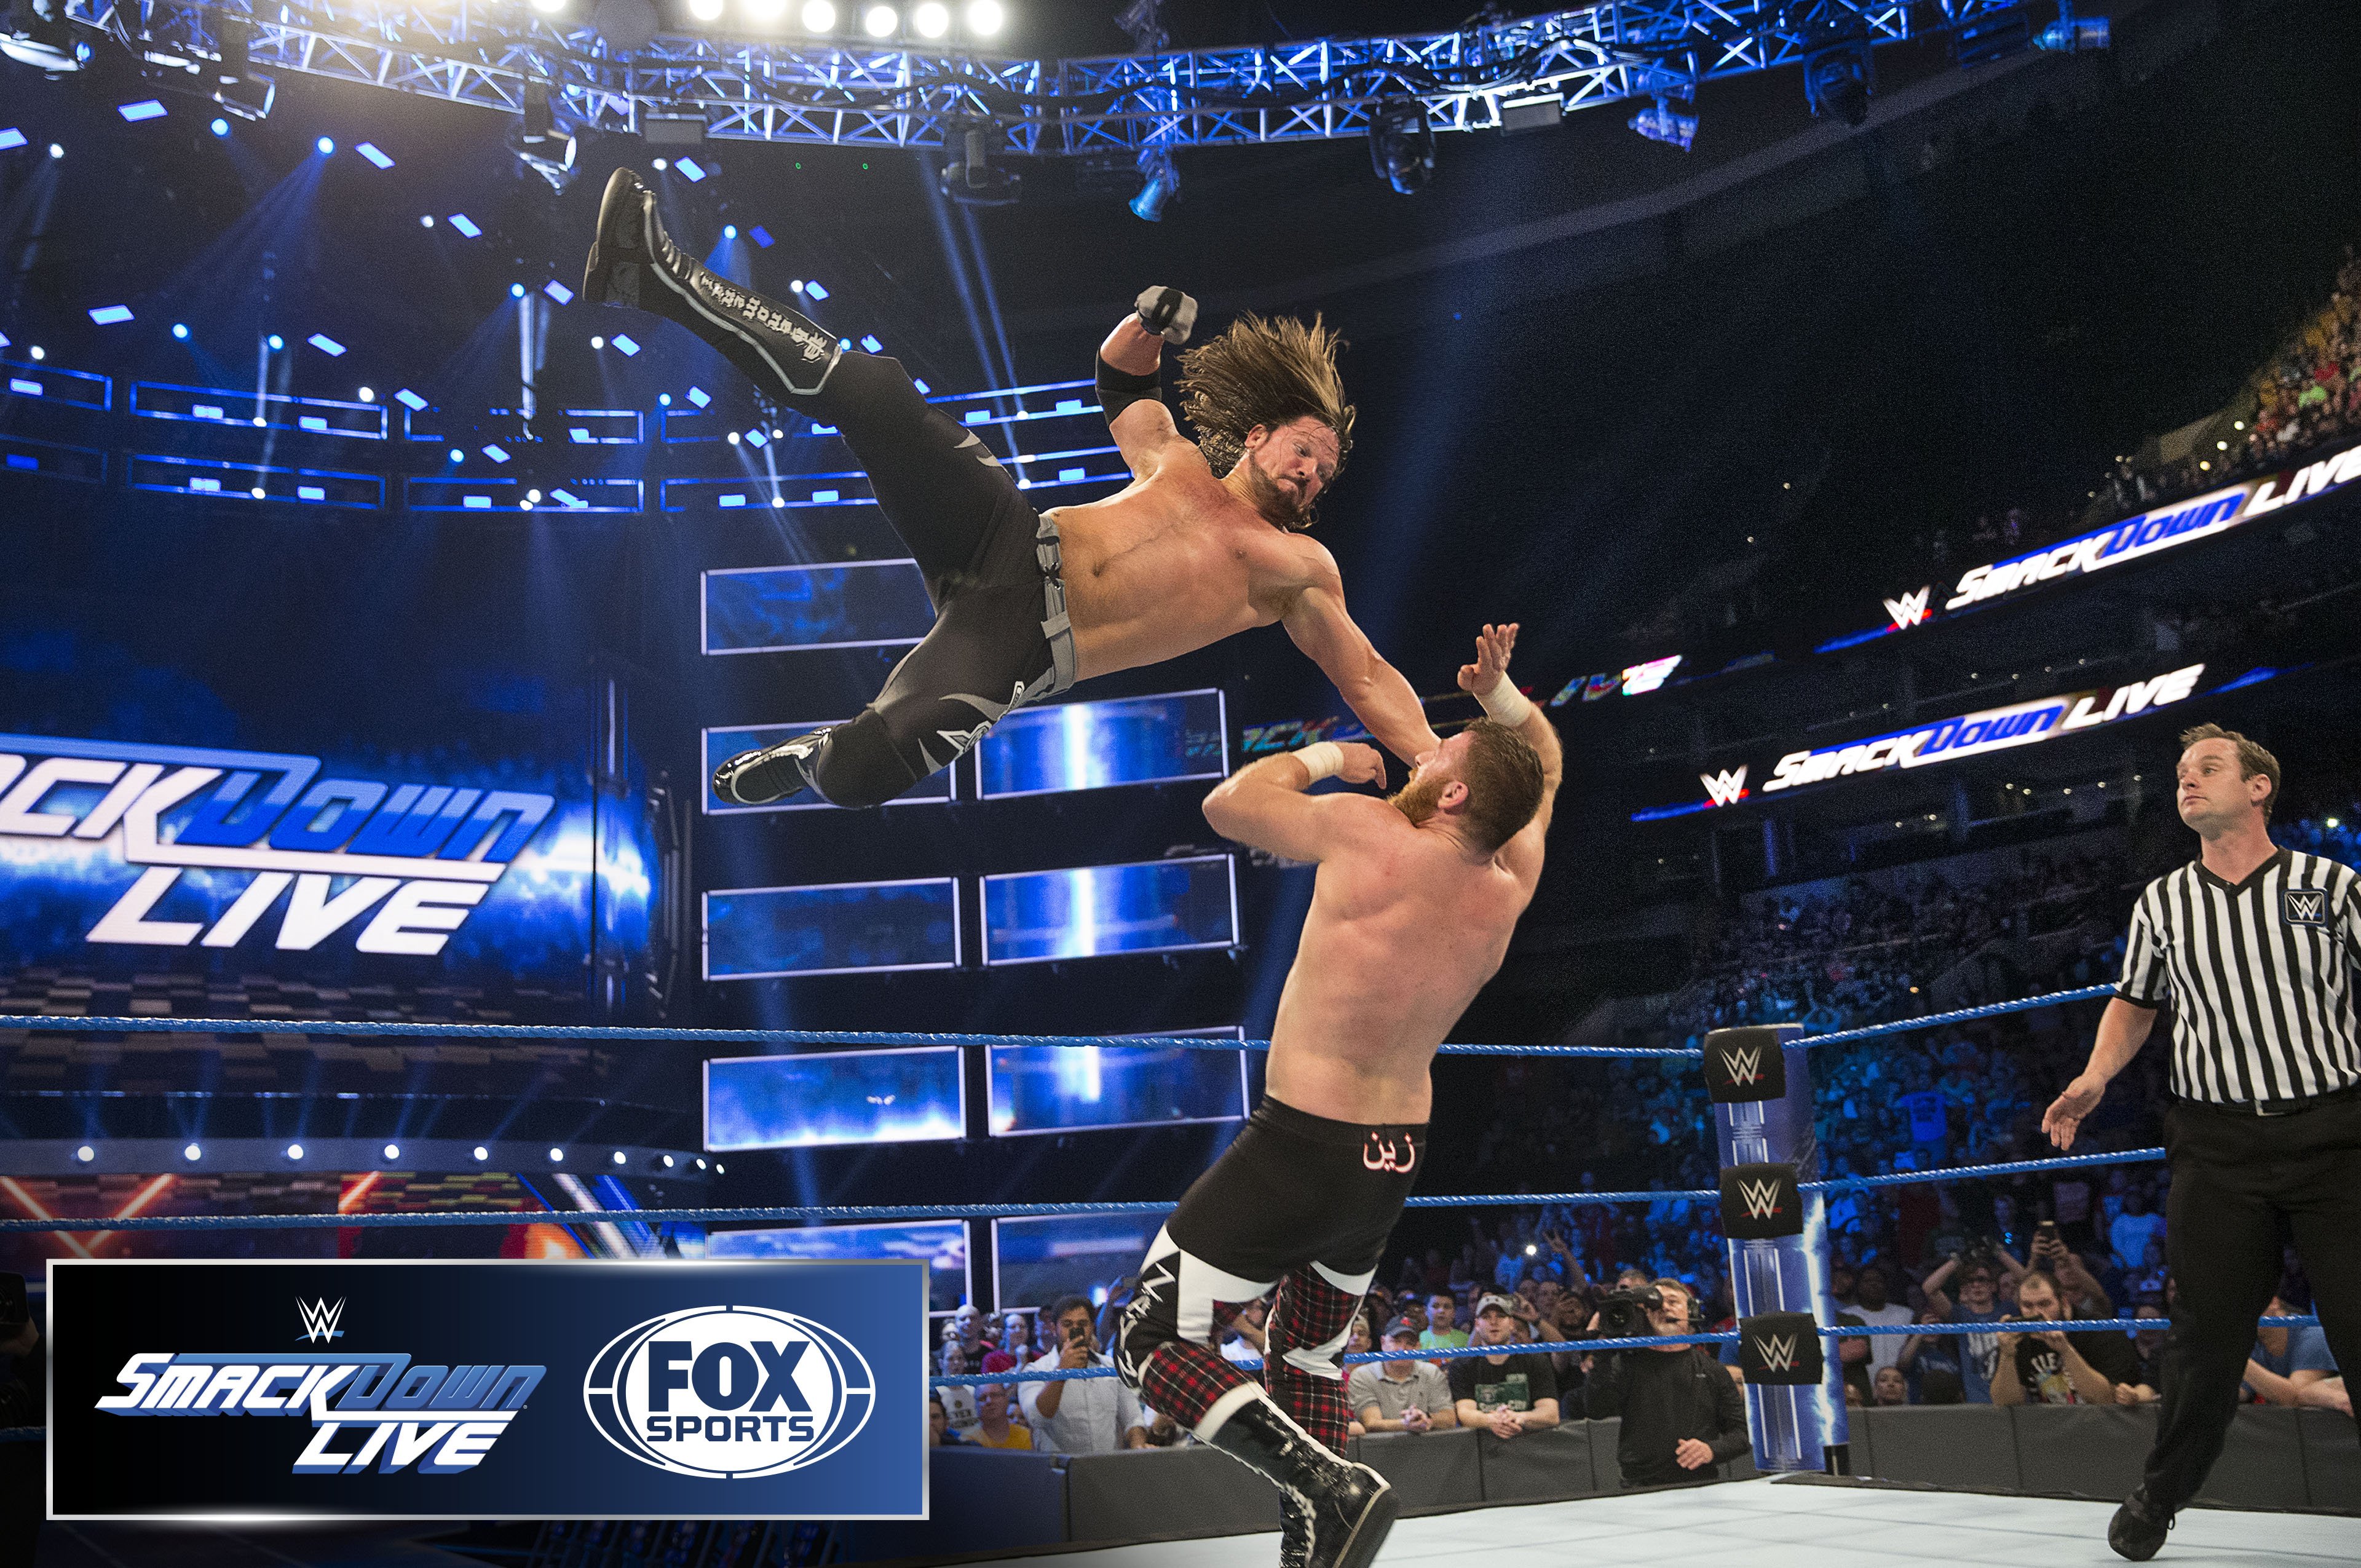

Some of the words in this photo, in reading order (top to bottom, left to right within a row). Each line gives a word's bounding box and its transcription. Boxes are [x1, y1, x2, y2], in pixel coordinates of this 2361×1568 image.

[2063, 663, 2205, 731] LIVE
[0, 733, 556, 881] CKDOWN
[86, 866, 490, 954] LIVE
[1362, 1131, 1415, 1174] زين
